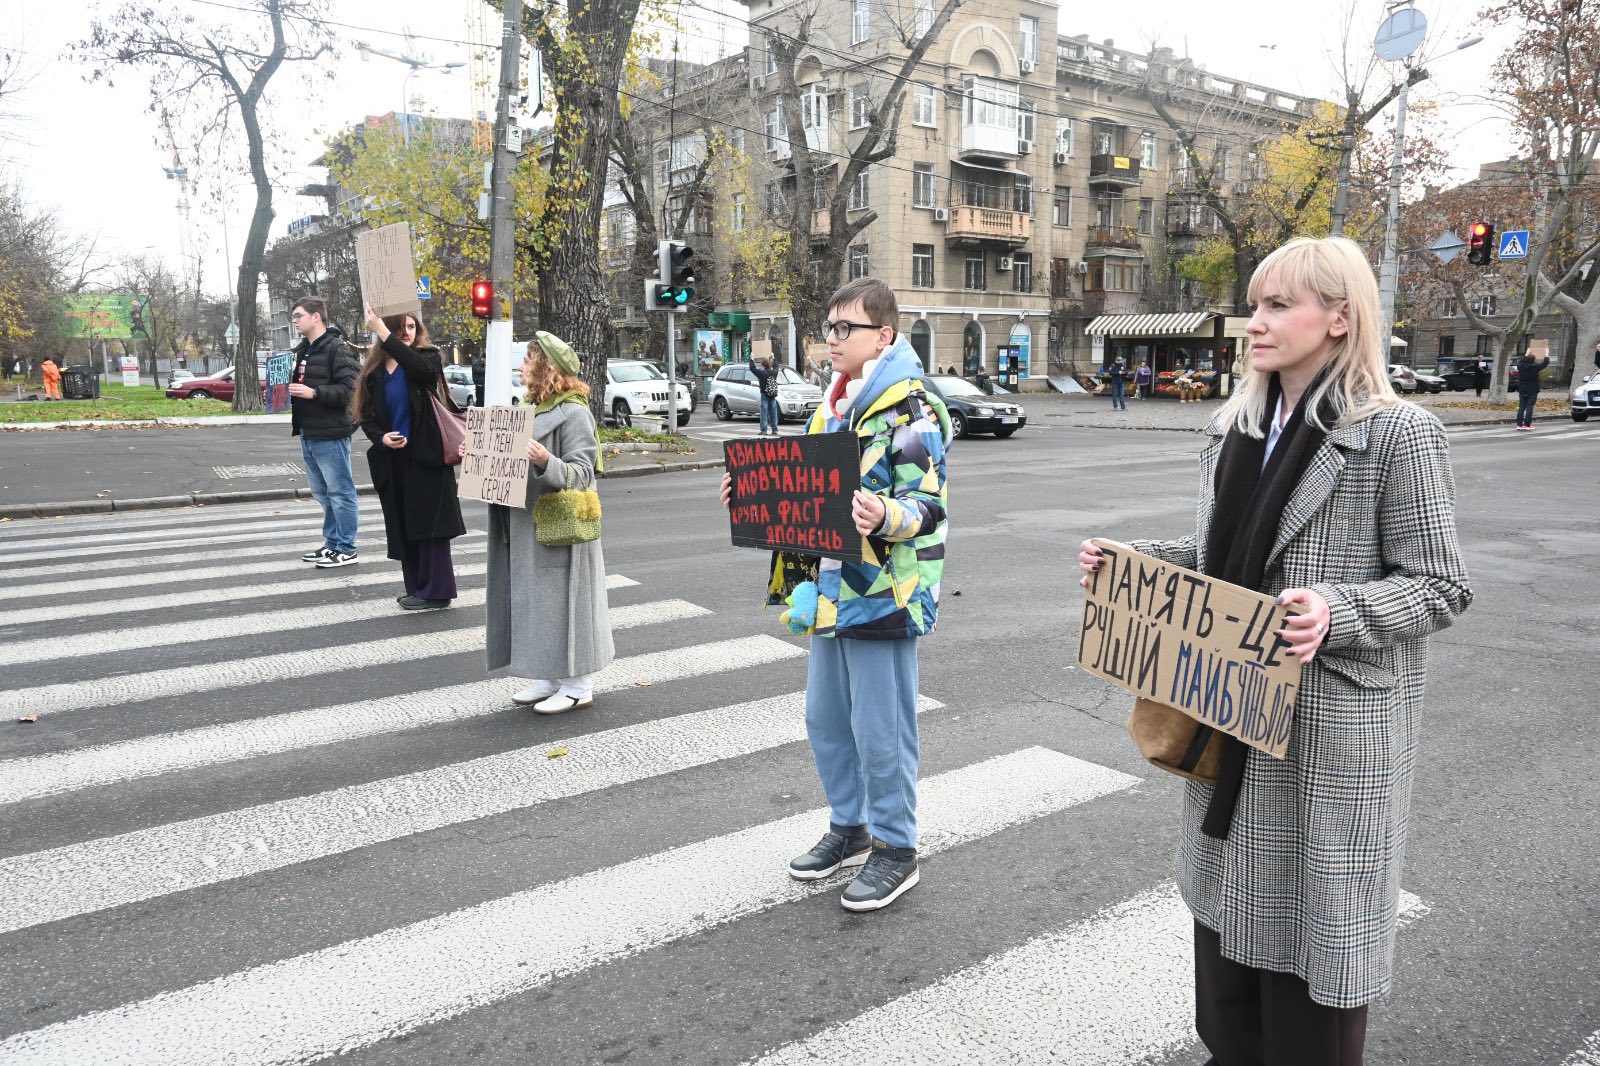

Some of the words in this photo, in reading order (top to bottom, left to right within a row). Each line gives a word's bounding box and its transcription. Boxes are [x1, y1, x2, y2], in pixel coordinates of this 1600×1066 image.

[467, 409, 486, 431] ВОНИ
[489, 410, 526, 433] ВІДДАЛИ
[494, 432, 514, 453] МЕНІ
[727, 439, 804, 469] ХВИЛИНА
[465, 453, 488, 476] СТУКІТ
[490, 456, 527, 479] ВЛАСНОГО
[481, 477, 511, 504] СЕРЦЯ
[736, 464, 840, 499] МОВЧАННЯ
[731, 504, 771, 525] КРУПА
[777, 496, 825, 525] ФАСТ
[766, 523, 843, 551] ЯПОНЕЦЬ
[1238, 599, 1301, 667] ЦЕ
[1078, 600, 1162, 697] РУШІЙ
[1170, 639, 1295, 752] МАЙБУТНЬОГО
